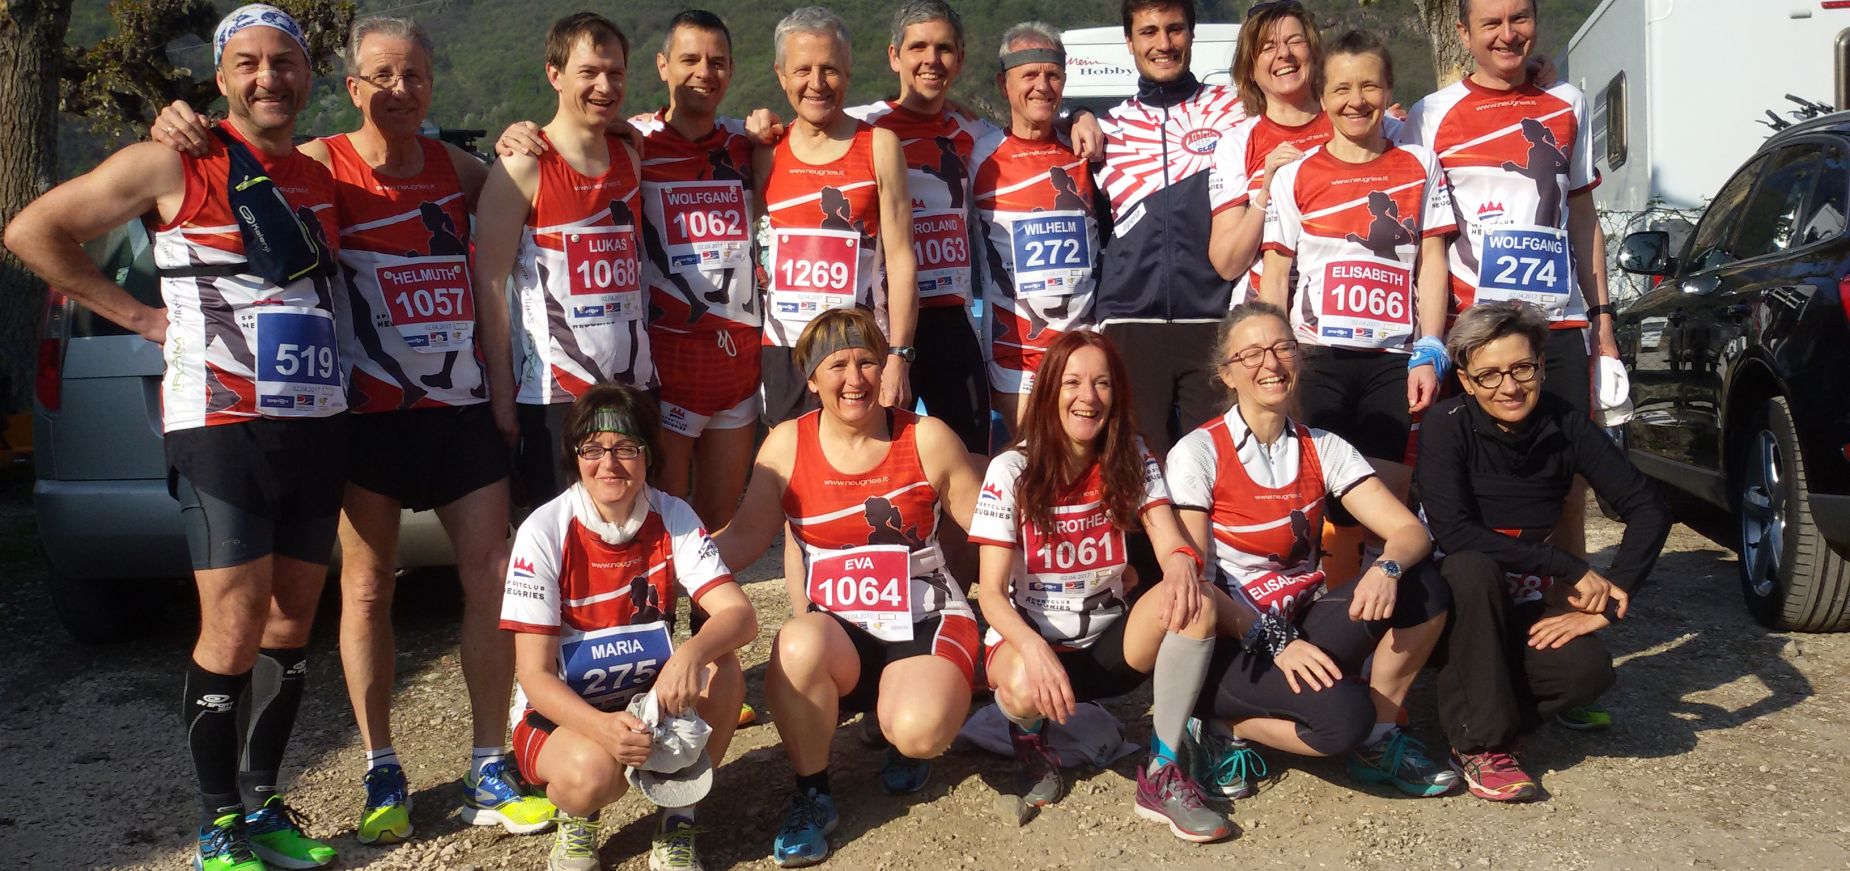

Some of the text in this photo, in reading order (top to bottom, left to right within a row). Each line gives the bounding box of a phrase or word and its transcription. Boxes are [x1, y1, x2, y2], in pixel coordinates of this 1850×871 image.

[1080, 67, 1135, 76] Hobby
[789, 168, 845, 176] www.neugries.it
[1331, 175, 1389, 186] www.neugries.it
[667, 192, 738, 205] WOLFGANG
[673, 209, 742, 238] 1062
[914, 219, 957, 234] ROLAND
[1024, 221, 1077, 236] WILHELM
[252, 222, 272, 253] Kalenji
[588, 238, 628, 253] LUKAS
[1489, 236, 1562, 253] WOLFGANG
[914, 237, 966, 265] 1063
[1024, 238, 1081, 267] 272
[392, 268, 457, 285] HELMUTH
[576, 258, 636, 289] 1068
[781, 259, 849, 289] 1269
[1332, 265, 1404, 286] ELISABETH
[1494, 255, 1557, 287] 274
[395, 287, 465, 318] 1057
[1331, 283, 1404, 319] 1066
[275, 343, 334, 379] 519
[824, 475, 890, 487] www.neugries.it
[1037, 531, 1114, 569] 1061
[844, 556, 875, 571] EVA
[817, 576, 902, 607] 1064
[591, 638, 645, 660] MARIA
[582, 659, 657, 695] 275
